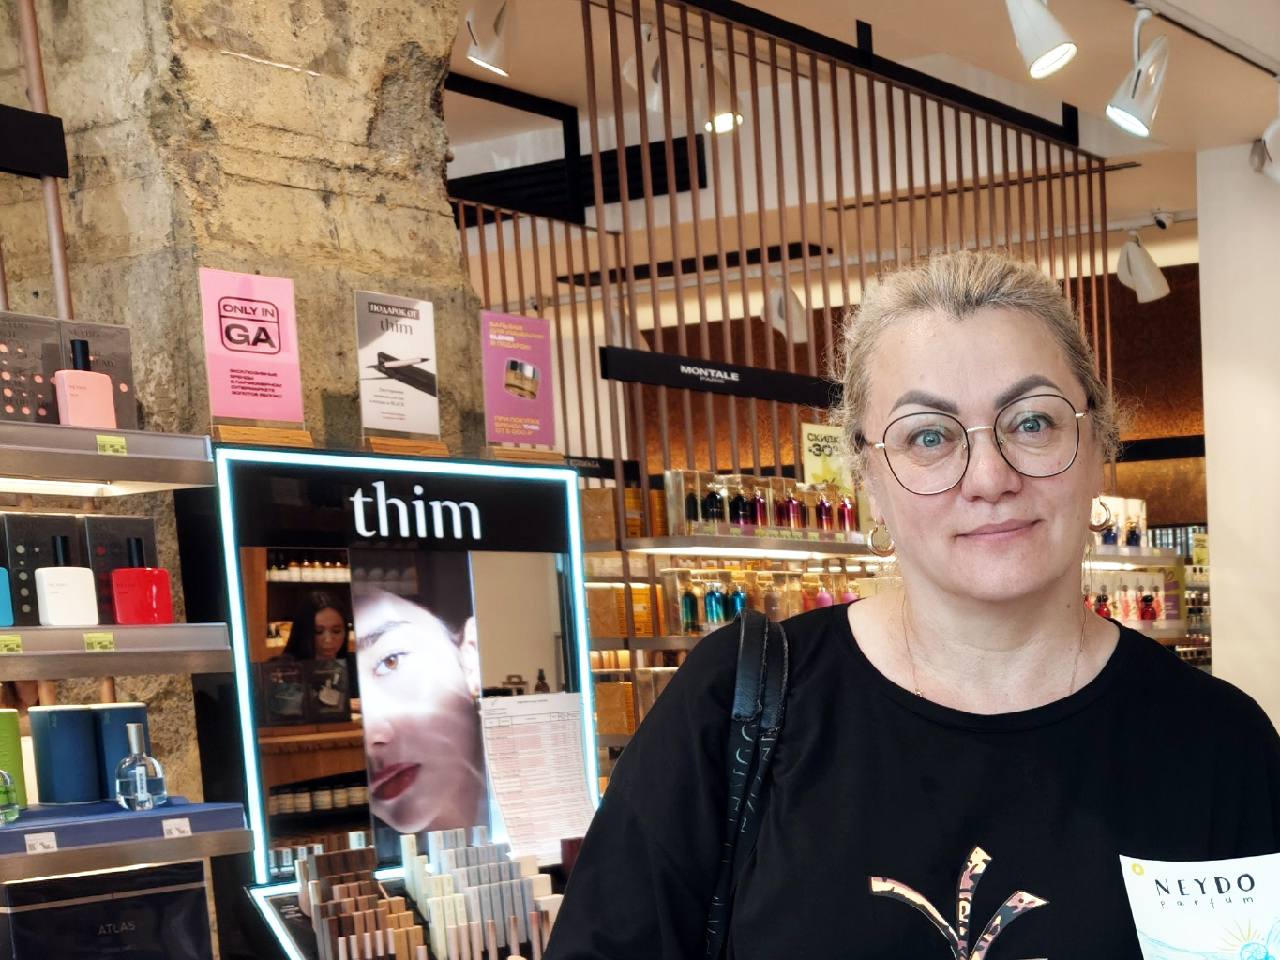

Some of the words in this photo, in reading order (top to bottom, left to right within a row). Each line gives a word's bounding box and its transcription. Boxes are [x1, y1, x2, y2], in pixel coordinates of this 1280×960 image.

[223, 304, 259, 316] ONLY
[262, 307, 275, 318] IN
[369, 303, 407, 316] ПОДАРОК
[407, 309, 418, 318] ОТ
[380, 319, 413, 335] thim
[225, 323, 276, 349] GA
[680, 364, 740, 382] MONTALE
[349, 481, 482, 540] thim
[1155, 873, 1256, 896] NEYDO
[1160, 896, 1254, 909] parfum
[98, 921, 136, 935] ATLAS
